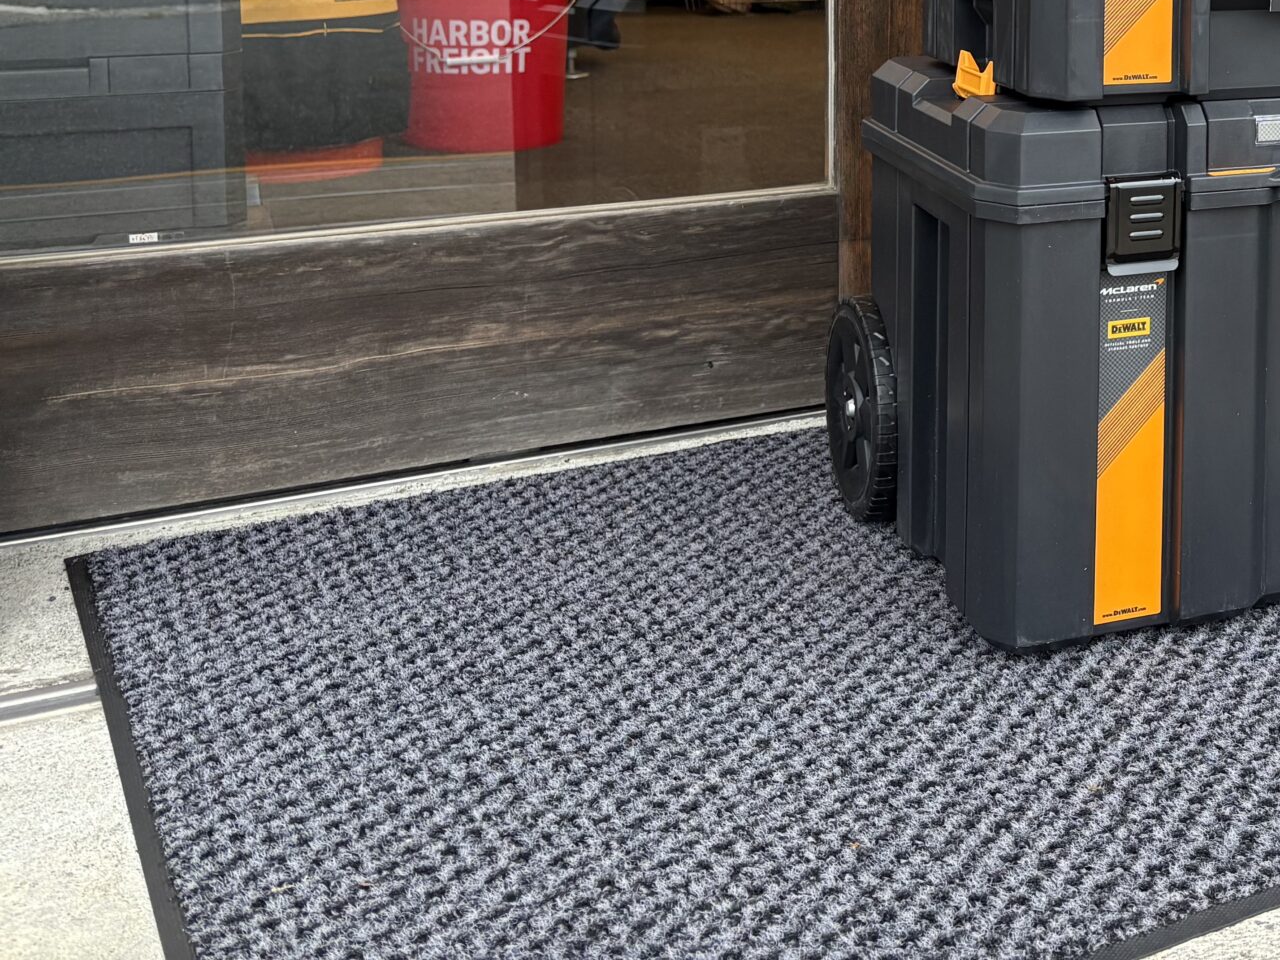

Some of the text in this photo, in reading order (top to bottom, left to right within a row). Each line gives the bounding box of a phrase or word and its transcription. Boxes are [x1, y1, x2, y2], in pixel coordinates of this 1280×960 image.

[412, 17, 531, 47] HARBOR
[412, 47, 532, 75] FREIGHT
[1100, 284, 1157, 295] McLaren
